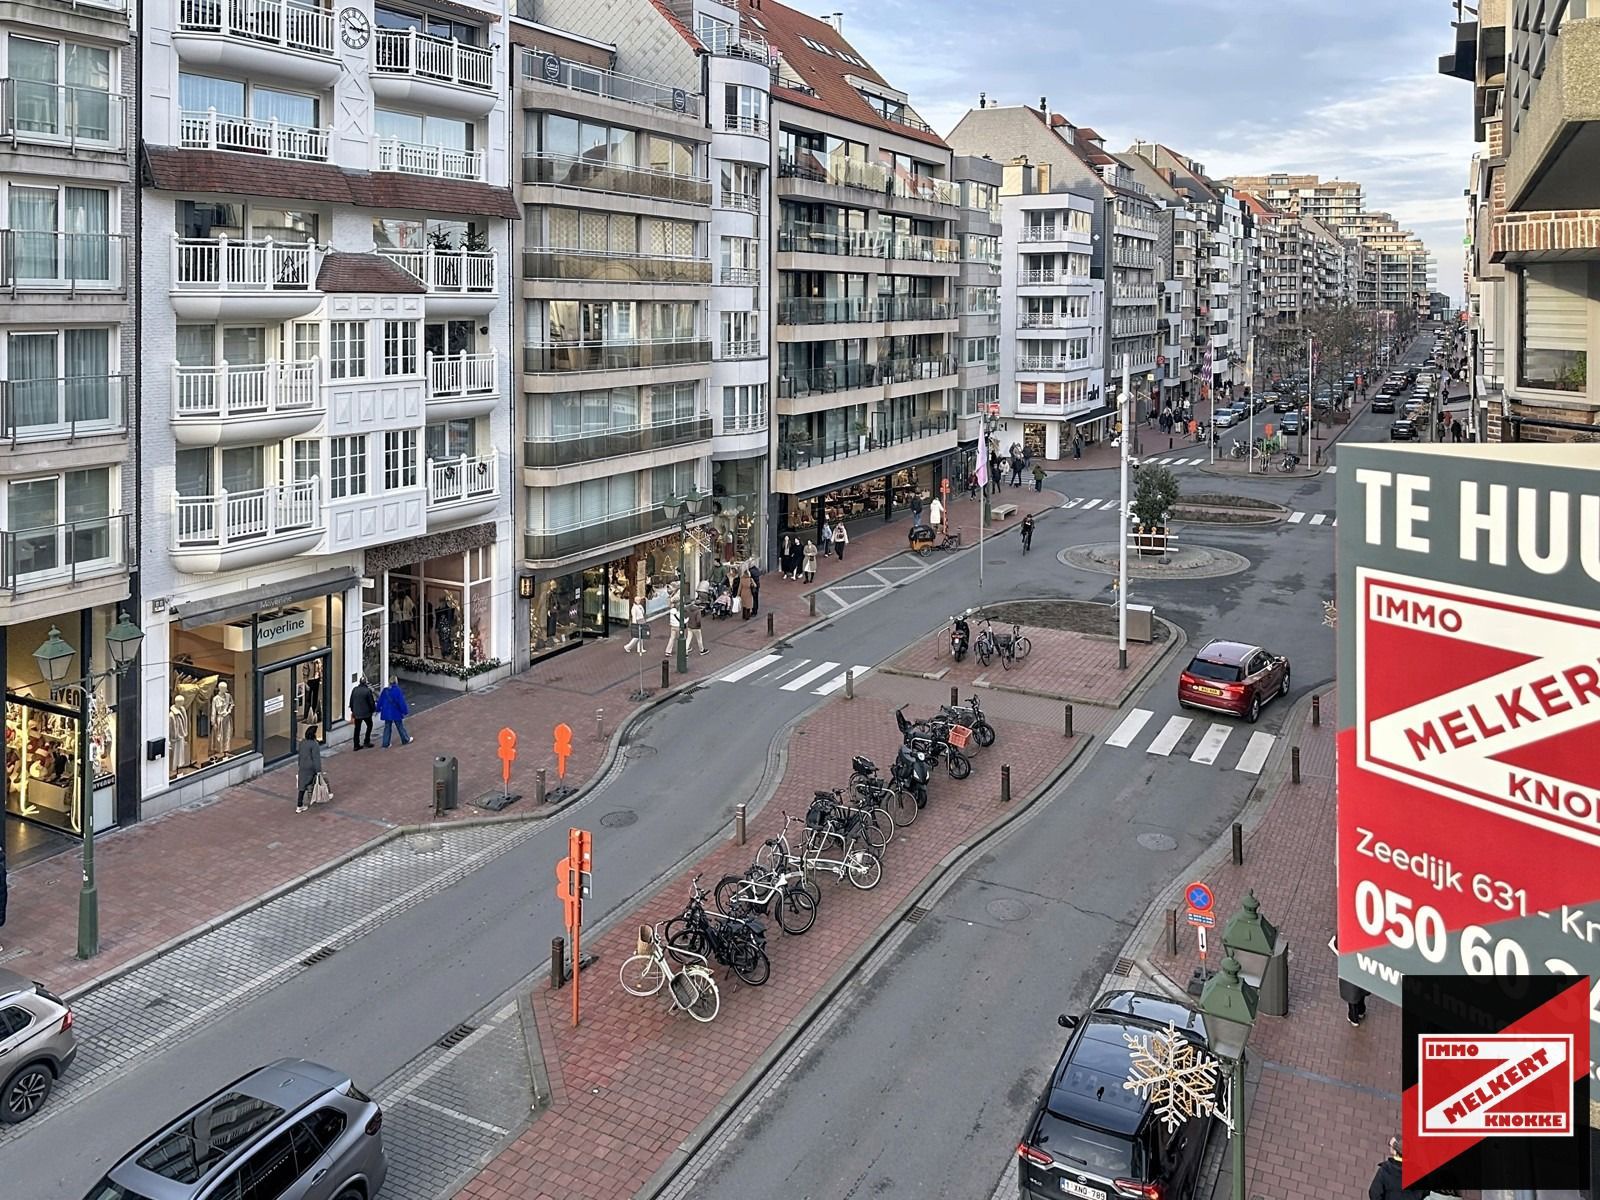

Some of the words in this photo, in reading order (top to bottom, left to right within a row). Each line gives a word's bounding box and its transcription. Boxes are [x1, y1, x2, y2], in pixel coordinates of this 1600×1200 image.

[1356, 468, 1430, 554] TE
[256, 619, 305, 640] Mayerline
[1377, 594, 1462, 633] IMMO
[1403, 657, 1600, 761] MELKER
[1509, 771, 1600, 824] KNO
[1355, 827, 1463, 893] Zeedijk
[1472, 873, 1528, 917] 631
[1354, 880, 1447, 964] 050
